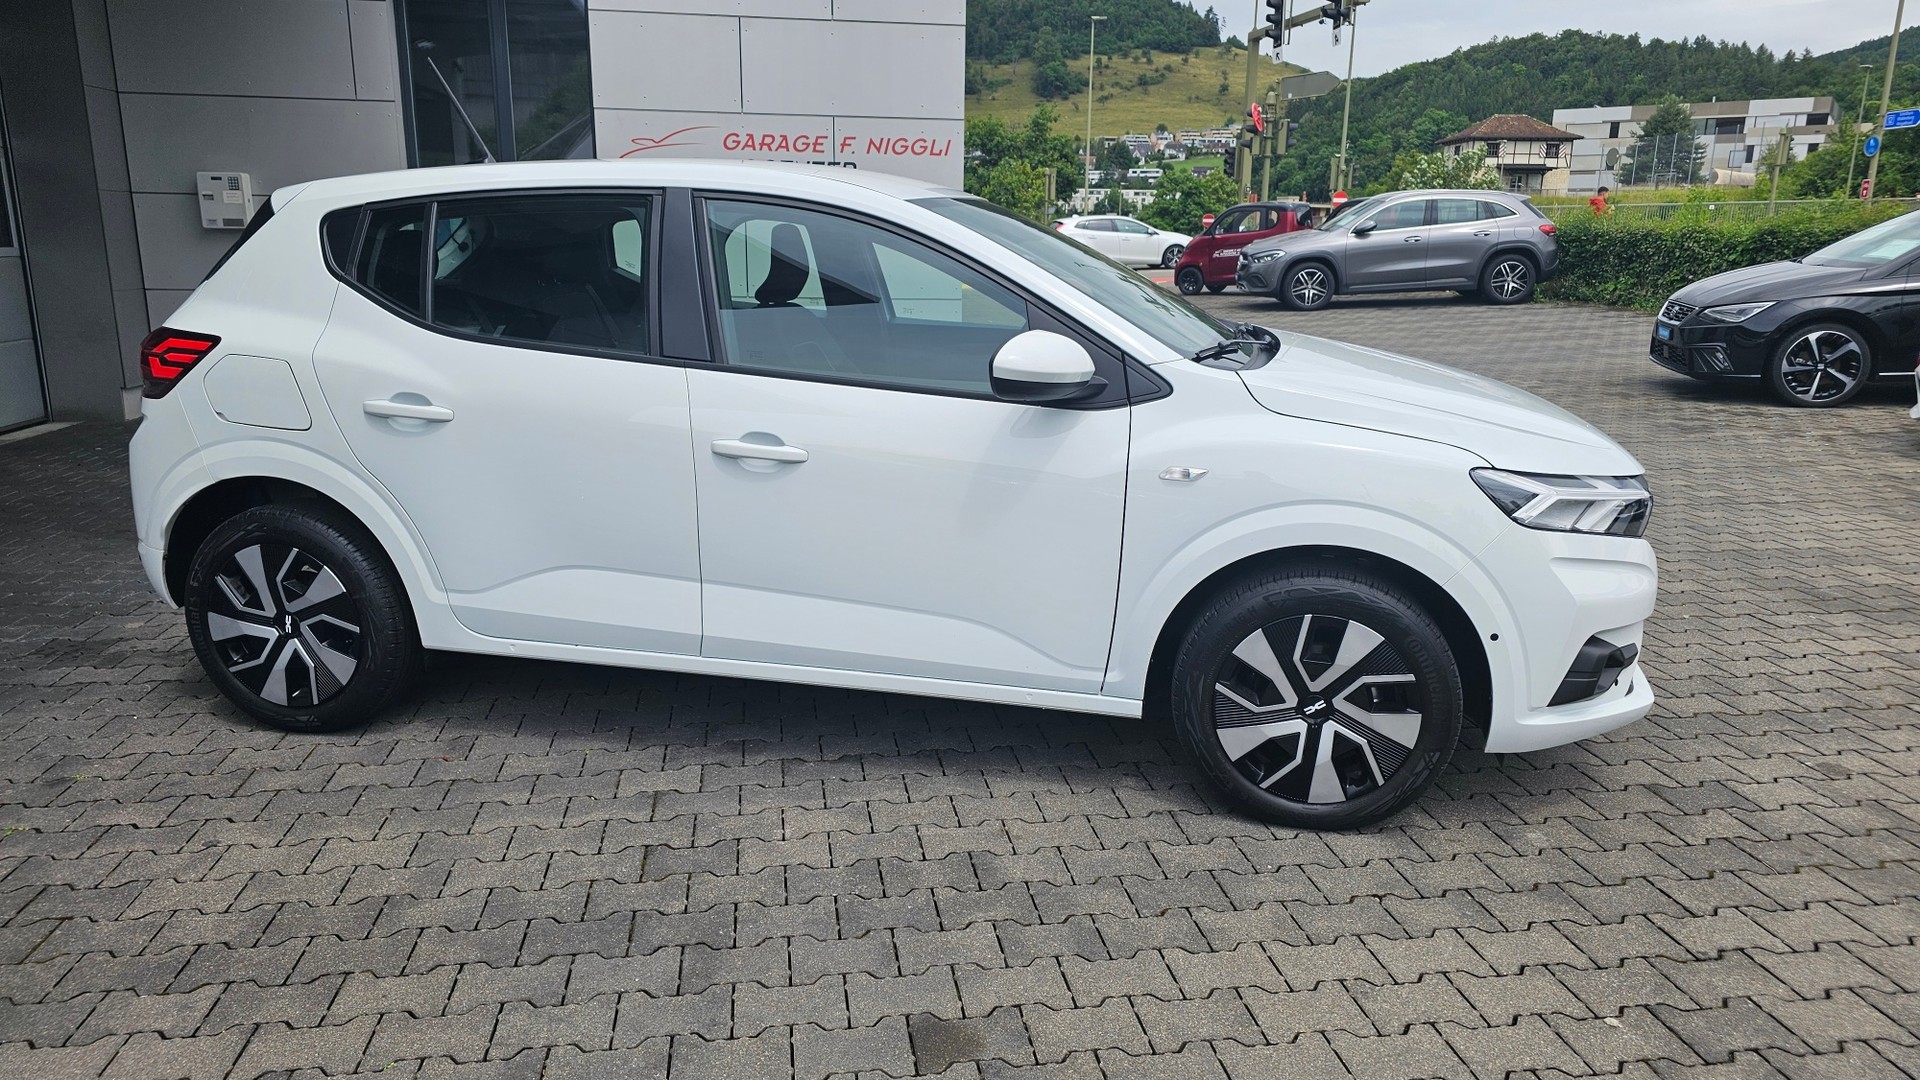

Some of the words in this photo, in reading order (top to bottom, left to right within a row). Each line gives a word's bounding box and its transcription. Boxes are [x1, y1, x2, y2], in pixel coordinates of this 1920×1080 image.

[722, 132, 829, 153] GARAGE
[839, 136, 857, 155] F.
[866, 137, 952, 157] NIGGLI
